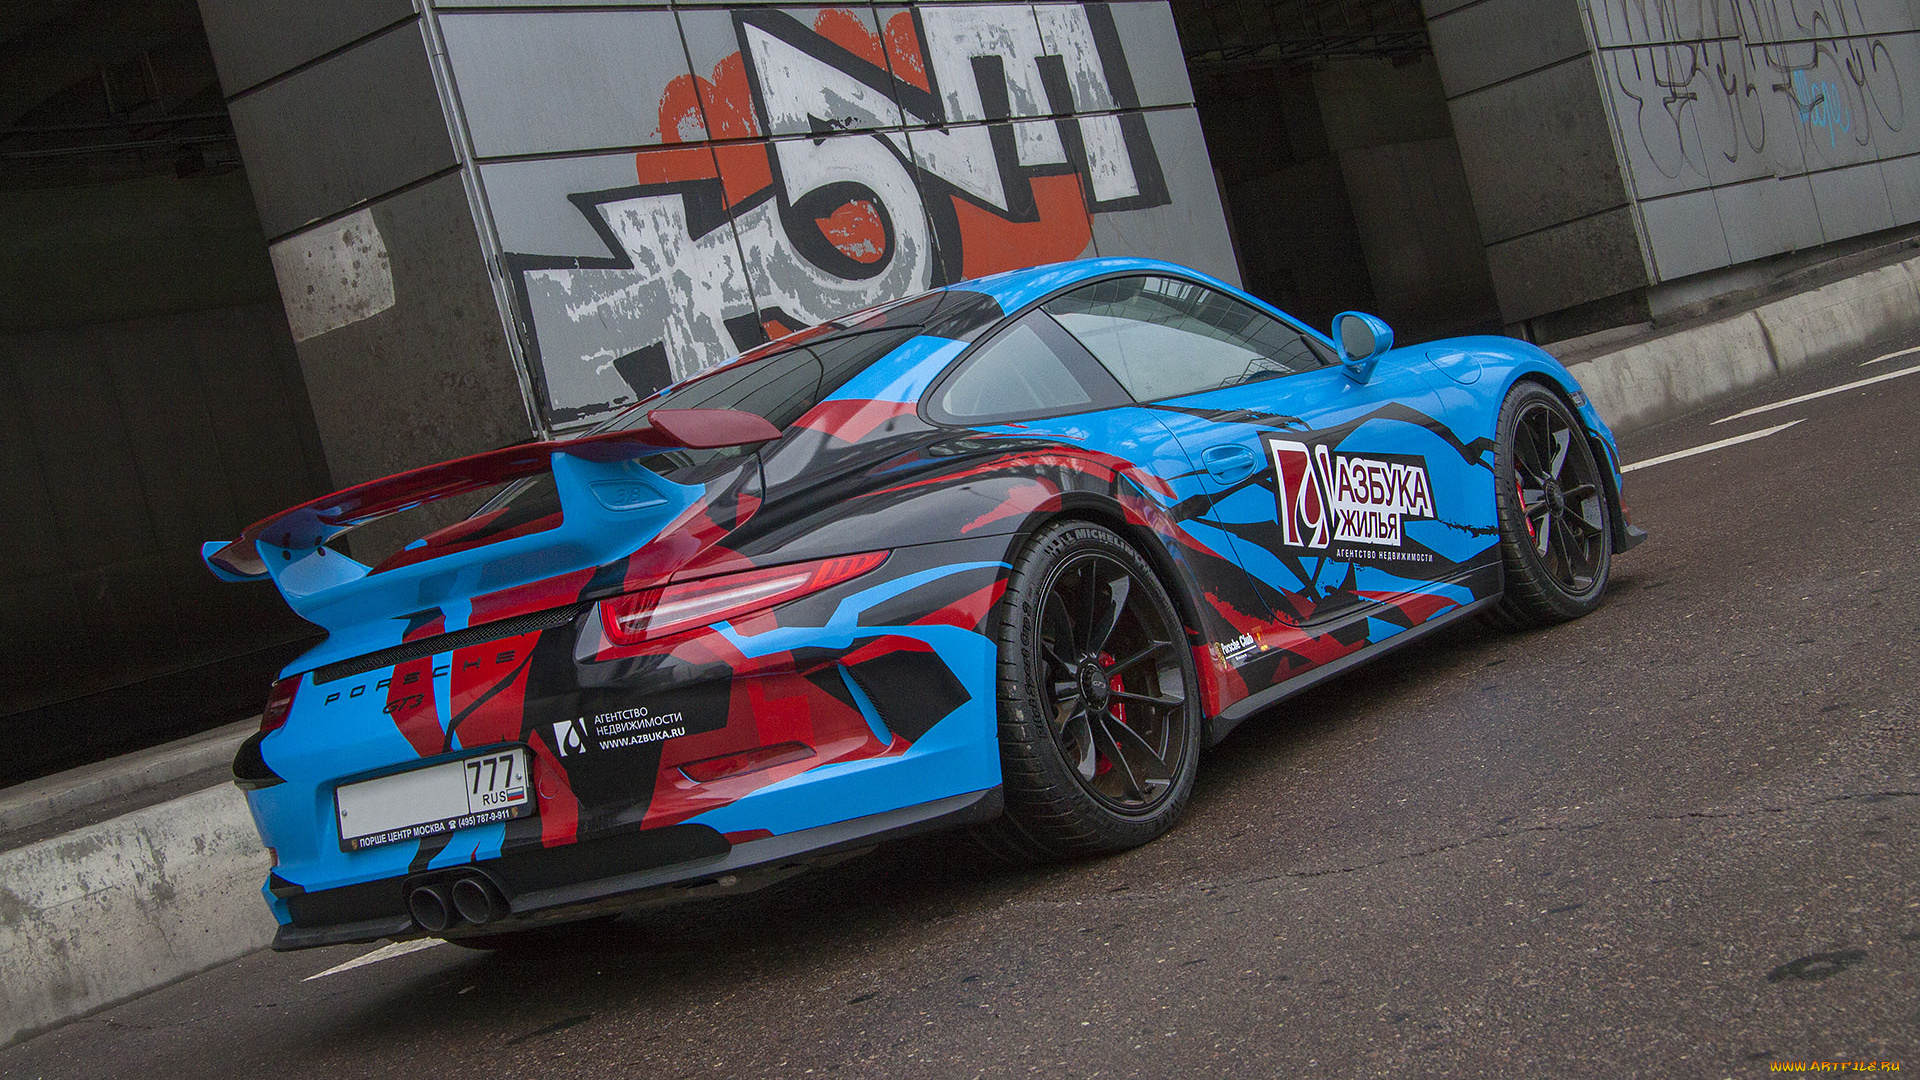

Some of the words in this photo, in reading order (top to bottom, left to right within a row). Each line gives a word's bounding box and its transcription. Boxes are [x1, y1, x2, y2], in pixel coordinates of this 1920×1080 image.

[1338, 464, 1428, 510] АЗБУКА
[1340, 509, 1398, 540] ЖИЛЬЯ
[1075, 528, 1136, 557] MICHELIN
[1336, 548, 1376, 559] АГЕНТСТВО
[1378, 551, 1433, 562] НЕДВИЖИМОСТИ
[324, 650, 516, 706] PORSCHE
[383, 693, 425, 715] GT3
[594, 706, 648, 725] АГЕНТСТВО
[596, 712, 683, 736] НЕДВИЖИМОСТИ
[599, 727, 686, 750] WWW.AZBUKA.RU
[467, 754, 514, 795] 777
[482, 791, 506, 806] RUS
[359, 833, 387, 848] ПОРШЕ
[388, 828, 412, 843] ЦЕНТР
[413, 822, 445, 836] МОСКВА
[458, 816, 476, 829] (495)
[476, 808, 510, 824] 787-9-911
